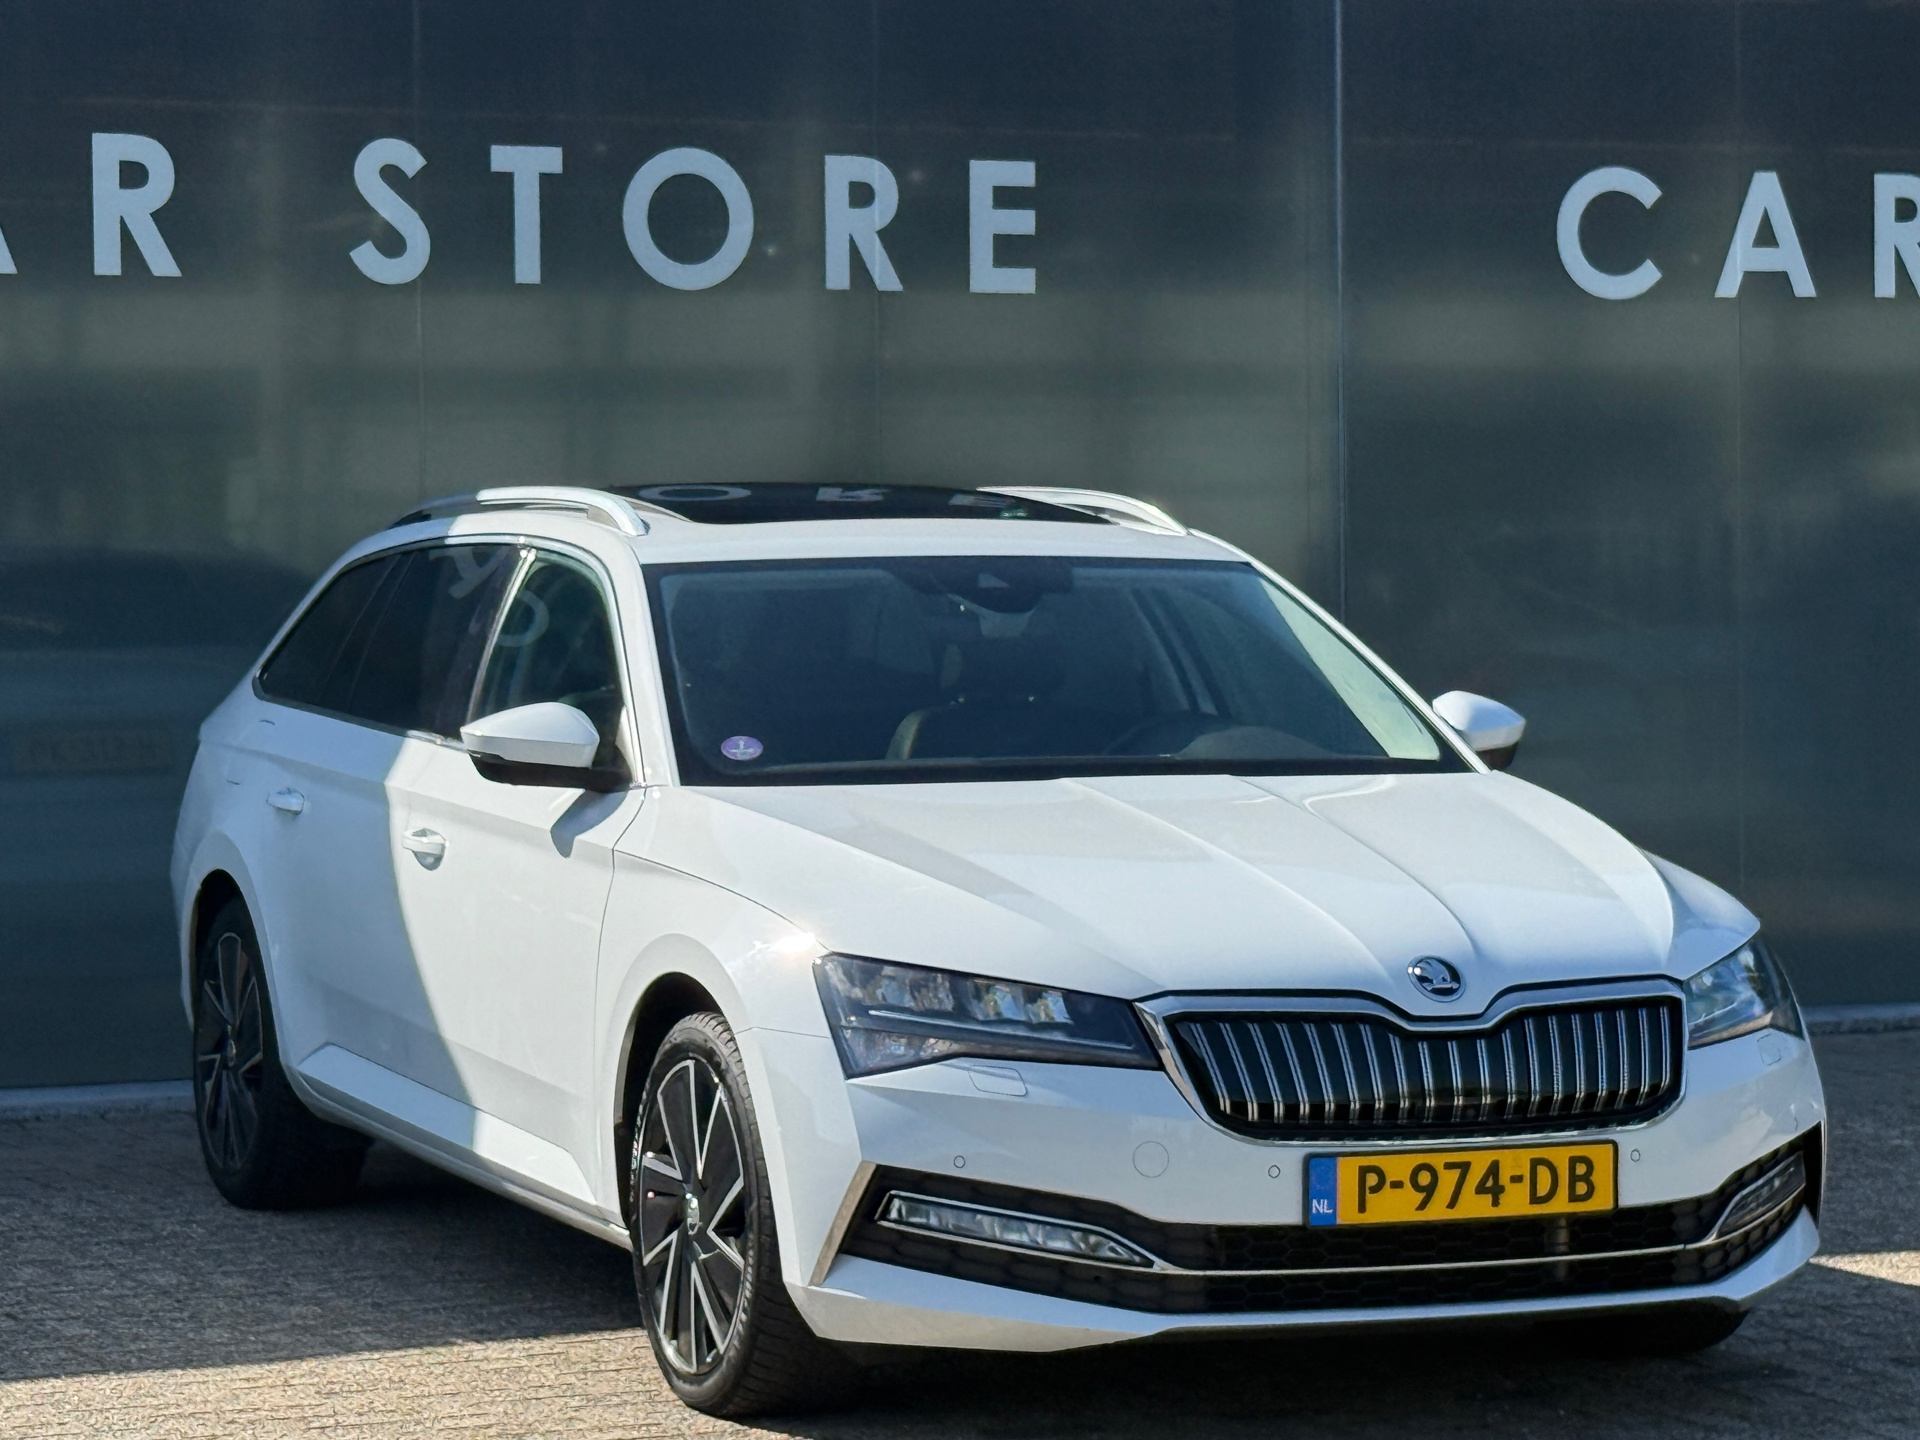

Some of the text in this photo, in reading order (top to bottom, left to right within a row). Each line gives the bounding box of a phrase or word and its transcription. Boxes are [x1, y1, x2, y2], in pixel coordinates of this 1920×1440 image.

[0, 132, 1036, 294] R STORE
[1556, 166, 1920, 300] CAR
[1311, 1155, 1596, 1214] NL P-974-DB
